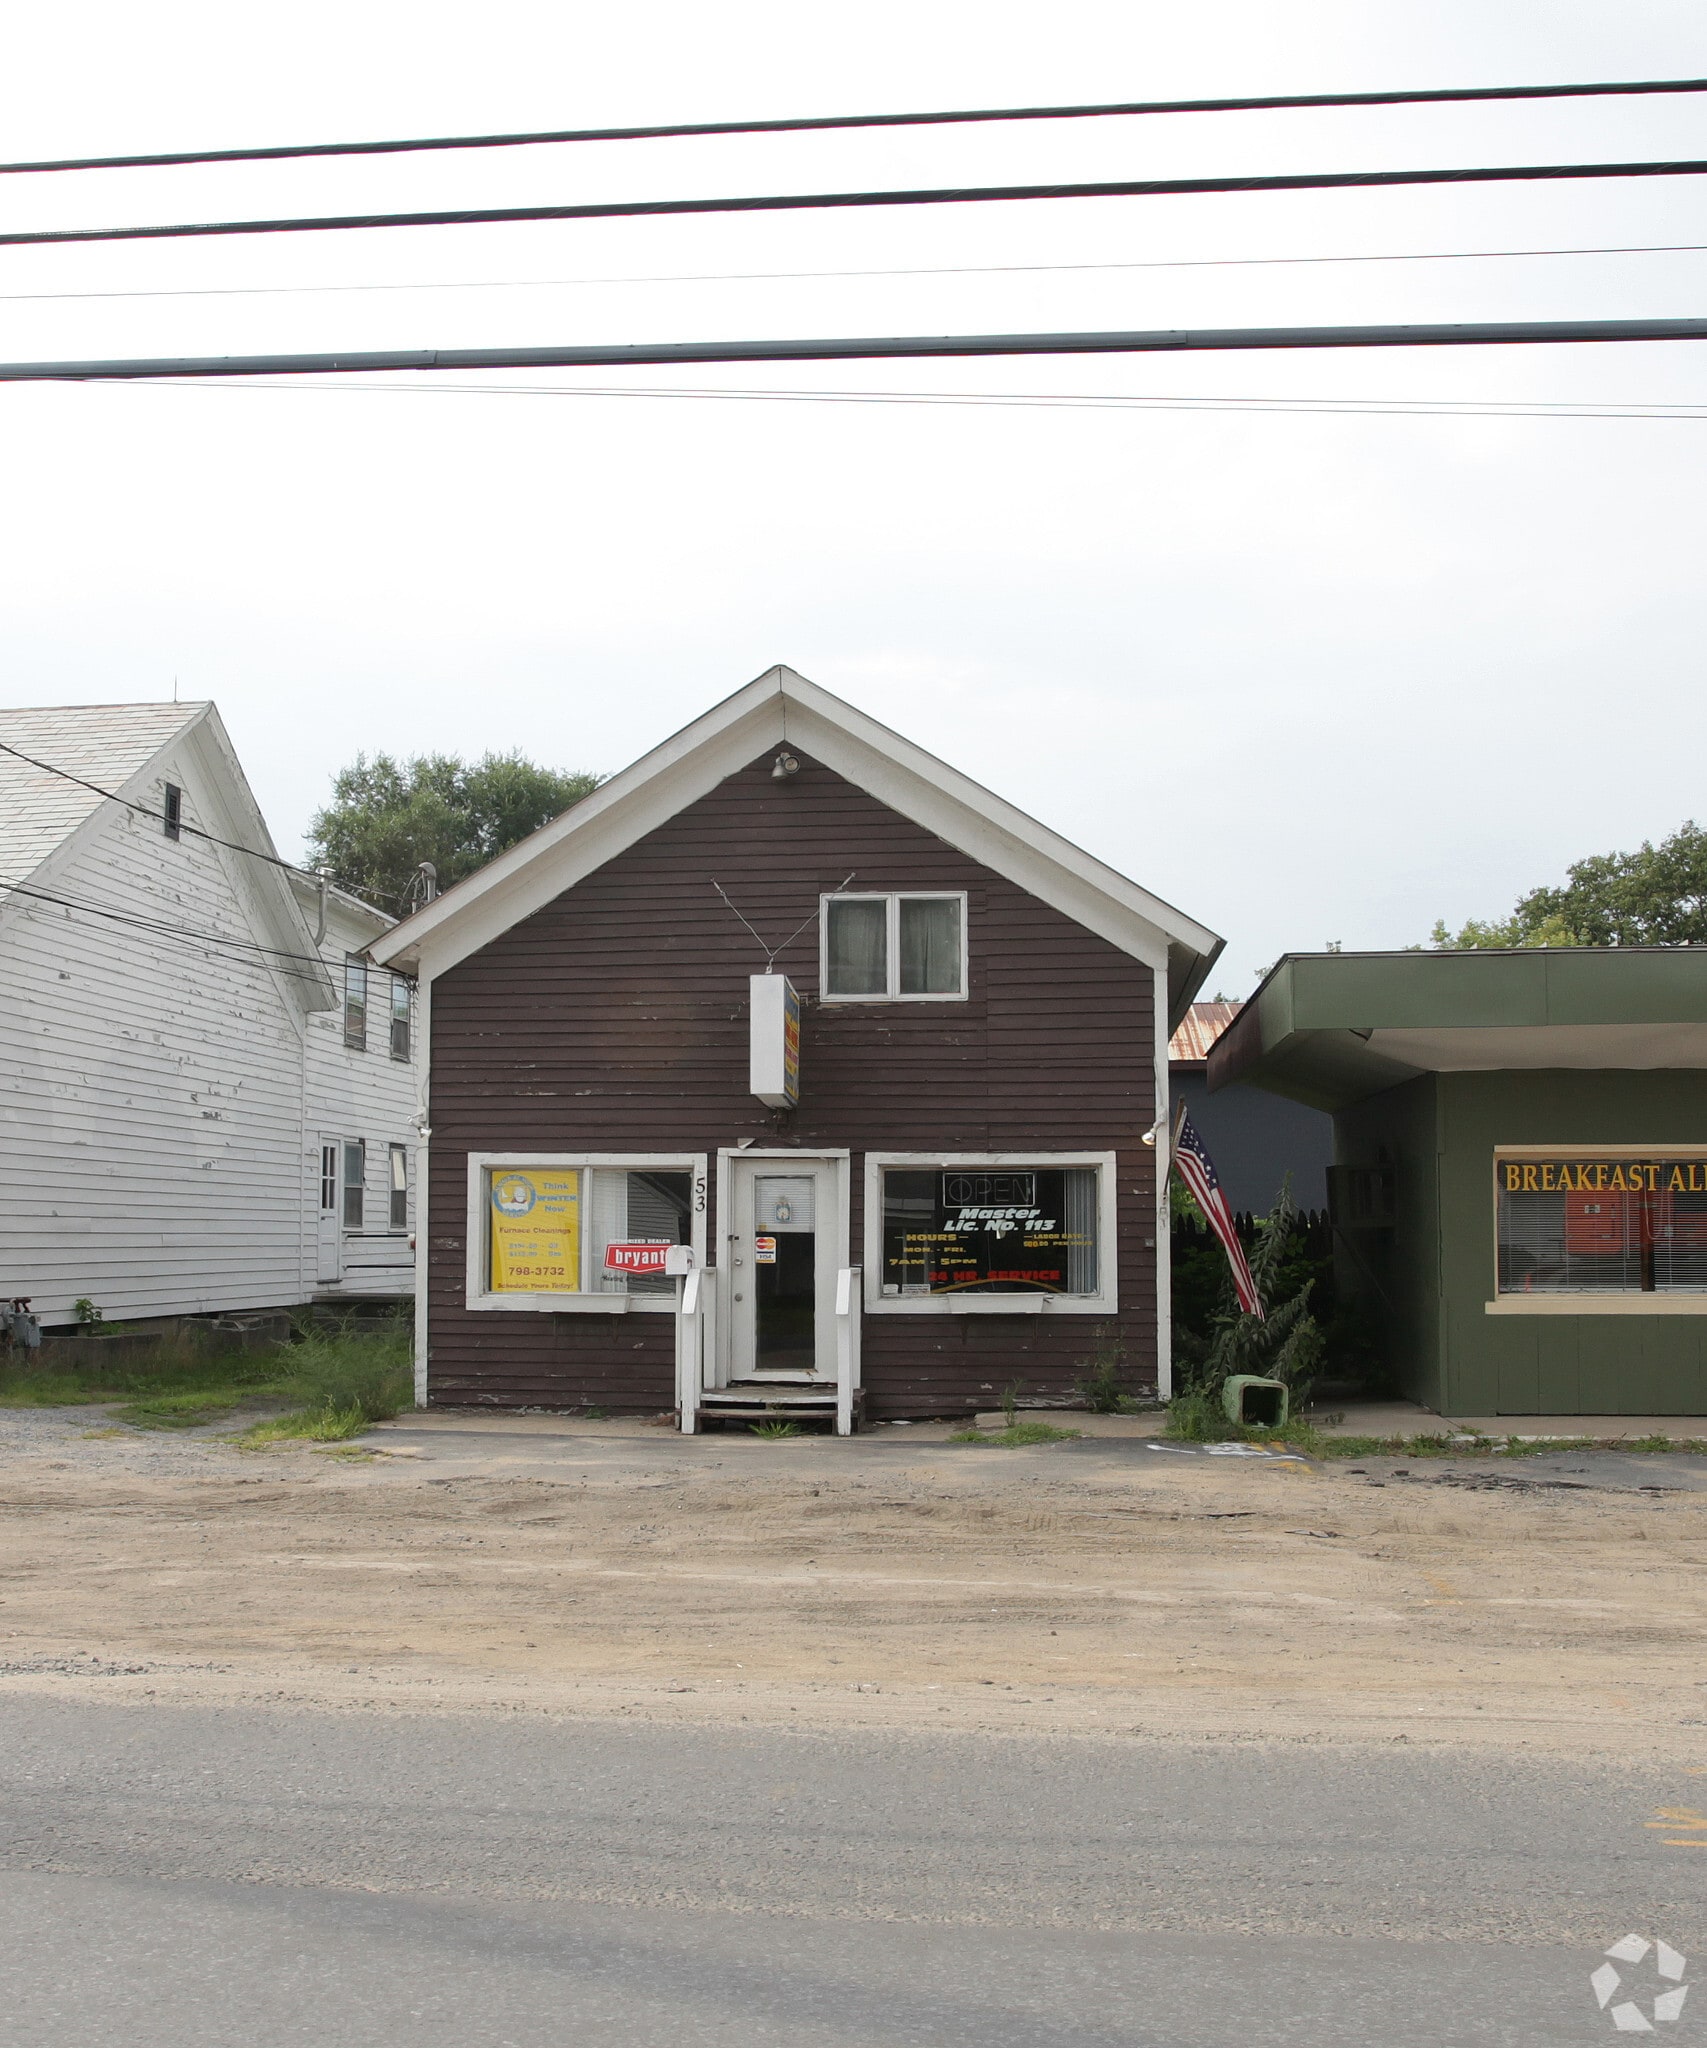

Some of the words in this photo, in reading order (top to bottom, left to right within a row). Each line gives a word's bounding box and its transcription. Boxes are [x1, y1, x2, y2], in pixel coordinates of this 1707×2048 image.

[1505, 1164, 1660, 1192] BREAKFAST
[1667, 1164, 1707, 1192] AL
[543, 1182, 569, 1190] Think
[949, 1178, 1030, 1202] OPEN
[695, 1177, 706, 1213] 53
[544, 1205, 567, 1213] Now
[958, 1208, 1041, 1220] Master
[533, 1227, 572, 1235] Cleanings
[943, 1220, 980, 1232] Lic.
[984, 1220, 1019, 1231] No.
[1025, 1220, 1057, 1231] 113
[906, 1233, 958, 1241] HOURS
[615, 1249, 666, 1267] bryant
[889, 1258, 926, 1266] 7AM
[508, 1266, 565, 1276] 798-3732
[928, 1271, 949, 1281] 24
[986, 1270, 1060, 1280] SERVICE
